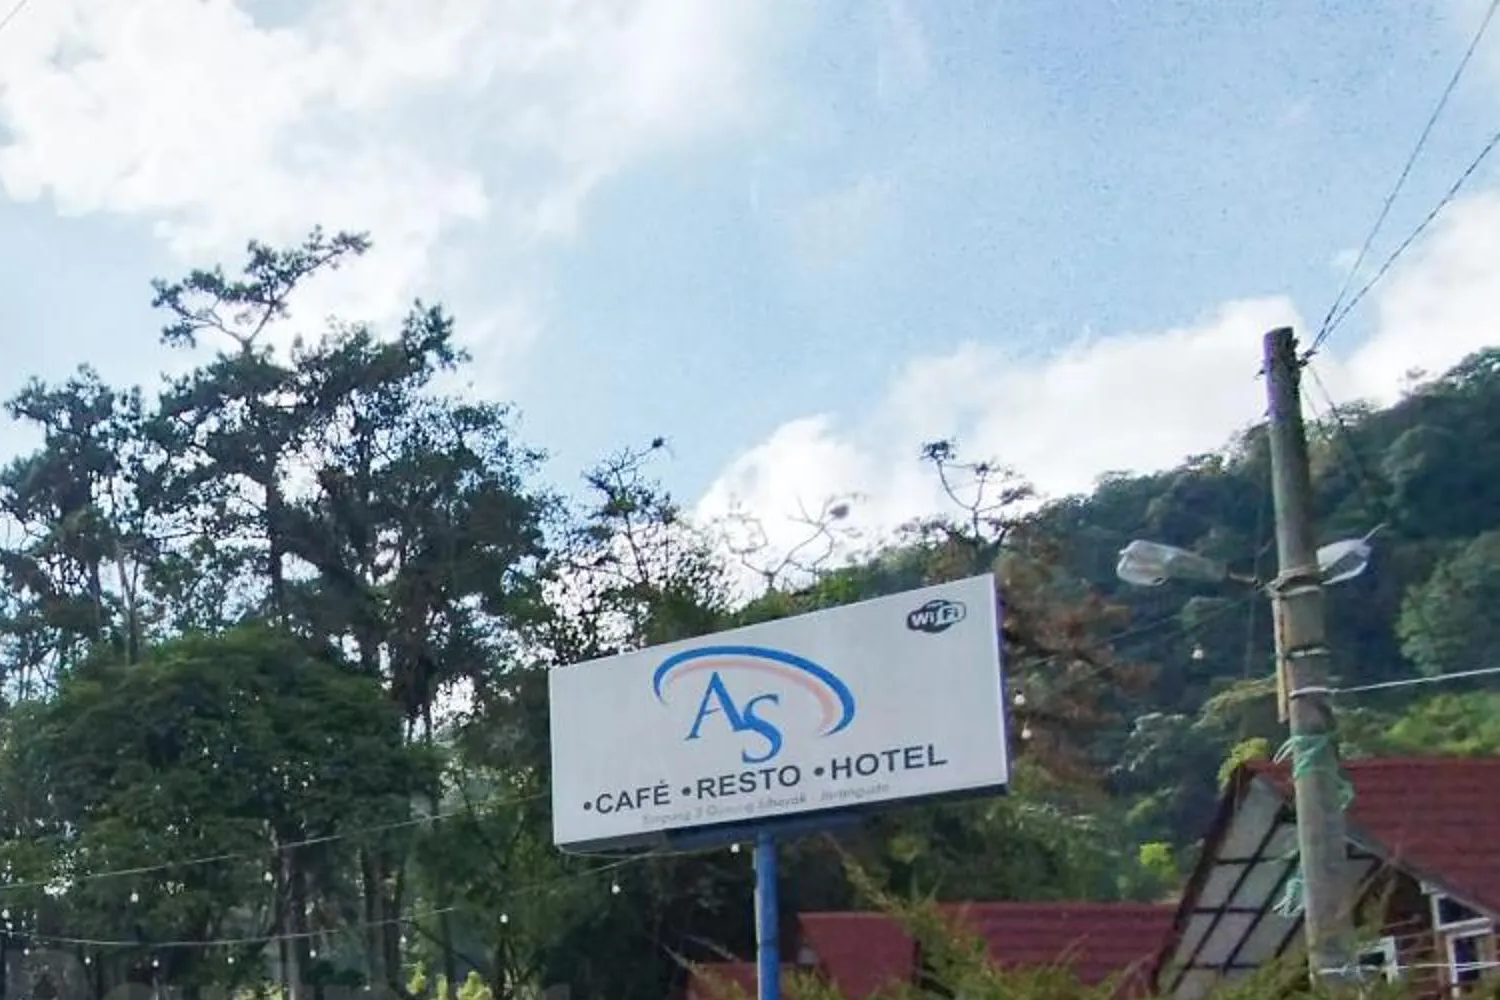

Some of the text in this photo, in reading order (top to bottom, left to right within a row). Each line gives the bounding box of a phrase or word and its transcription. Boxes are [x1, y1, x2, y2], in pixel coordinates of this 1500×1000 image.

[684, 671, 783, 764] AS
[595, 779, 671, 814] CAFÉ
[697, 765, 801, 800] RESTO
[831, 743, 948, 780] HOTEL
